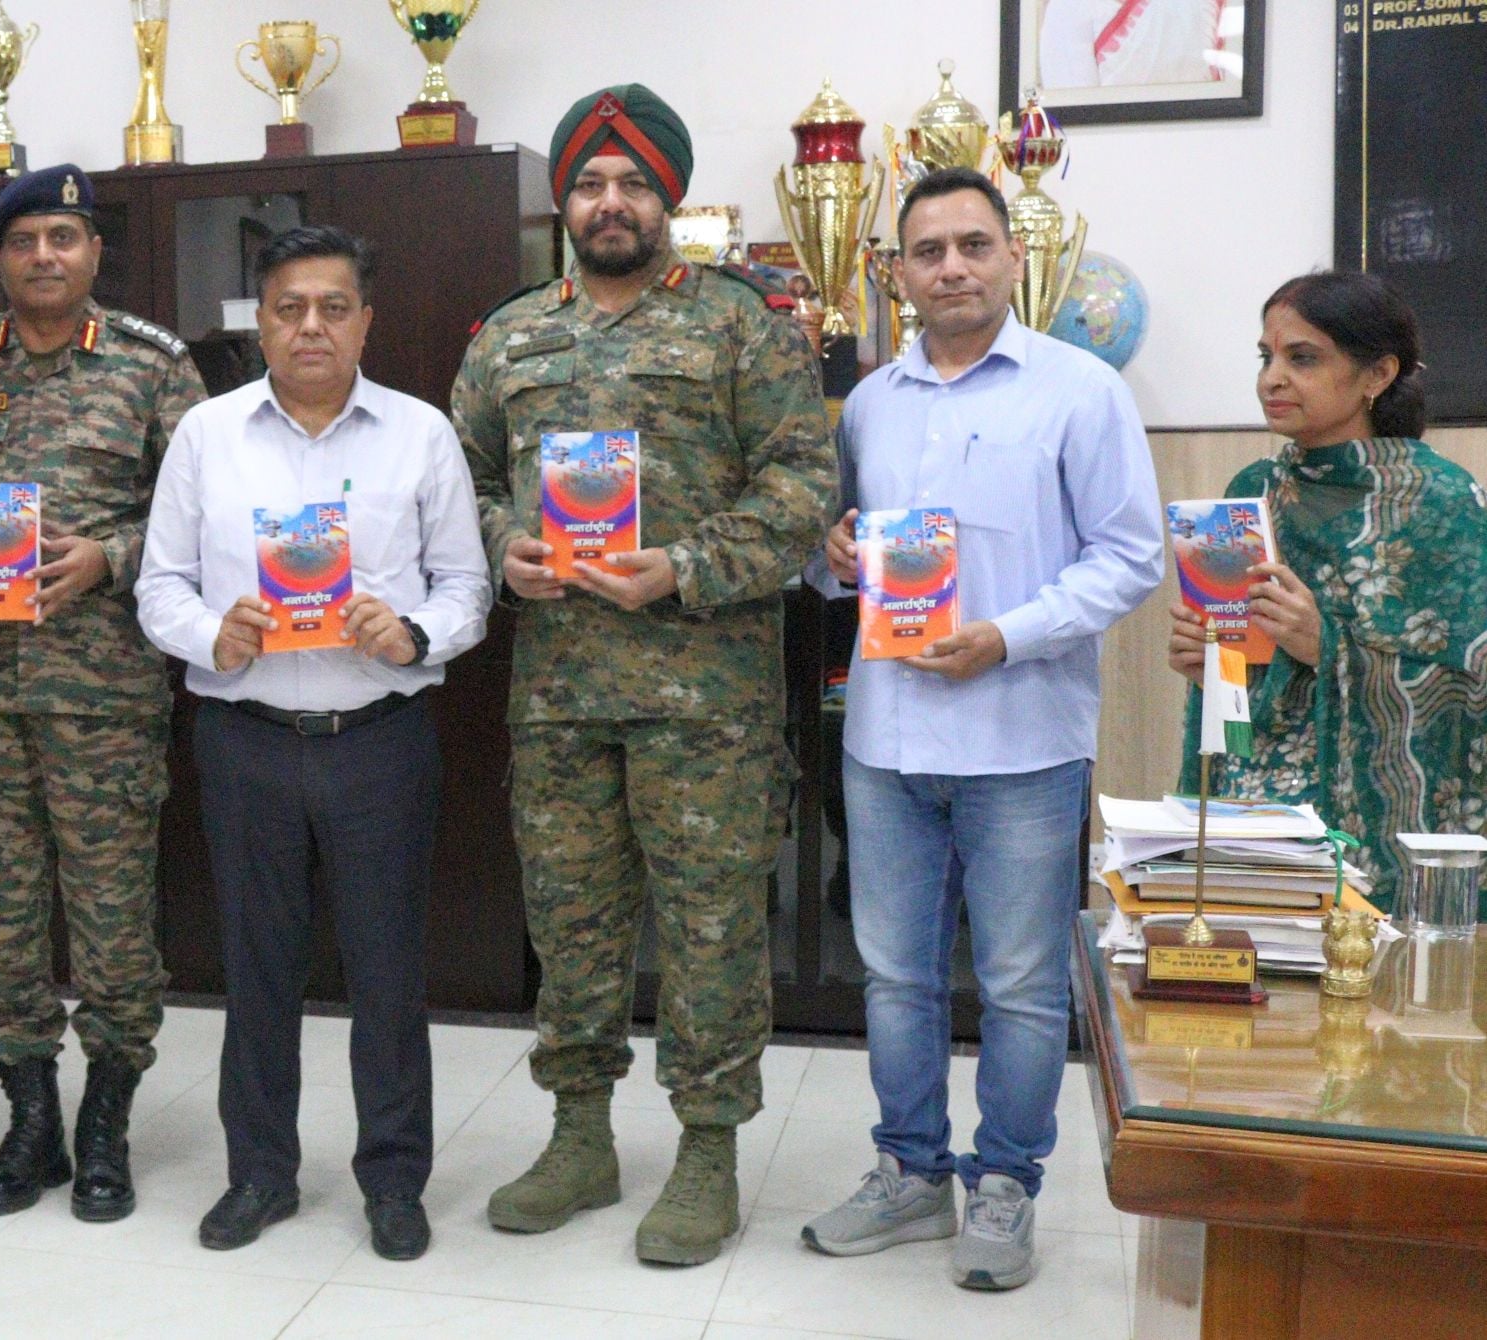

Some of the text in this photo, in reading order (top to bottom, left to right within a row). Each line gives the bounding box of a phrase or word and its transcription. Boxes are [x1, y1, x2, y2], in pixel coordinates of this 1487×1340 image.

[1344, 4, 1359, 16] 03
[1344, 21, 1359, 33] 04
[1205, 602, 1248, 616] अन्तर्राष्ट्री
